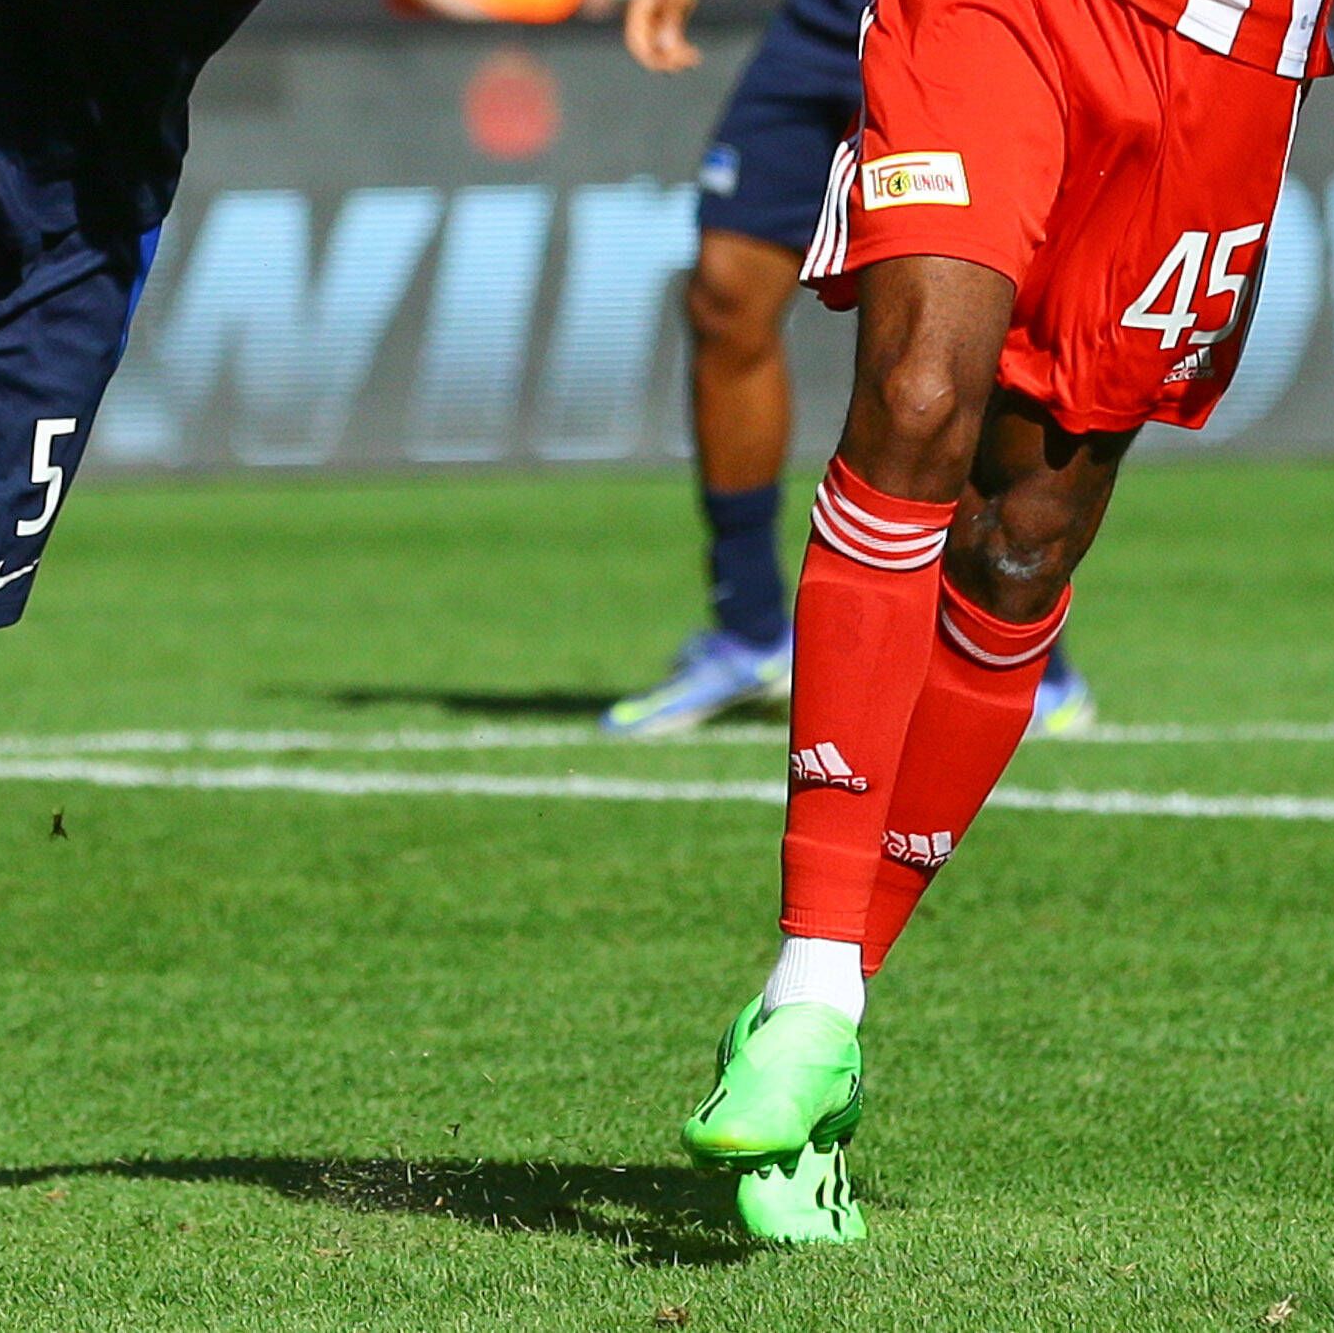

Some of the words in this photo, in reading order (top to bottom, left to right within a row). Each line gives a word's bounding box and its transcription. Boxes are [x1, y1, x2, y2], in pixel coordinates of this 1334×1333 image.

[913, 172, 955, 193] UNION
[1121, 222, 1265, 350] 45
[17, 418, 77, 536] 5
